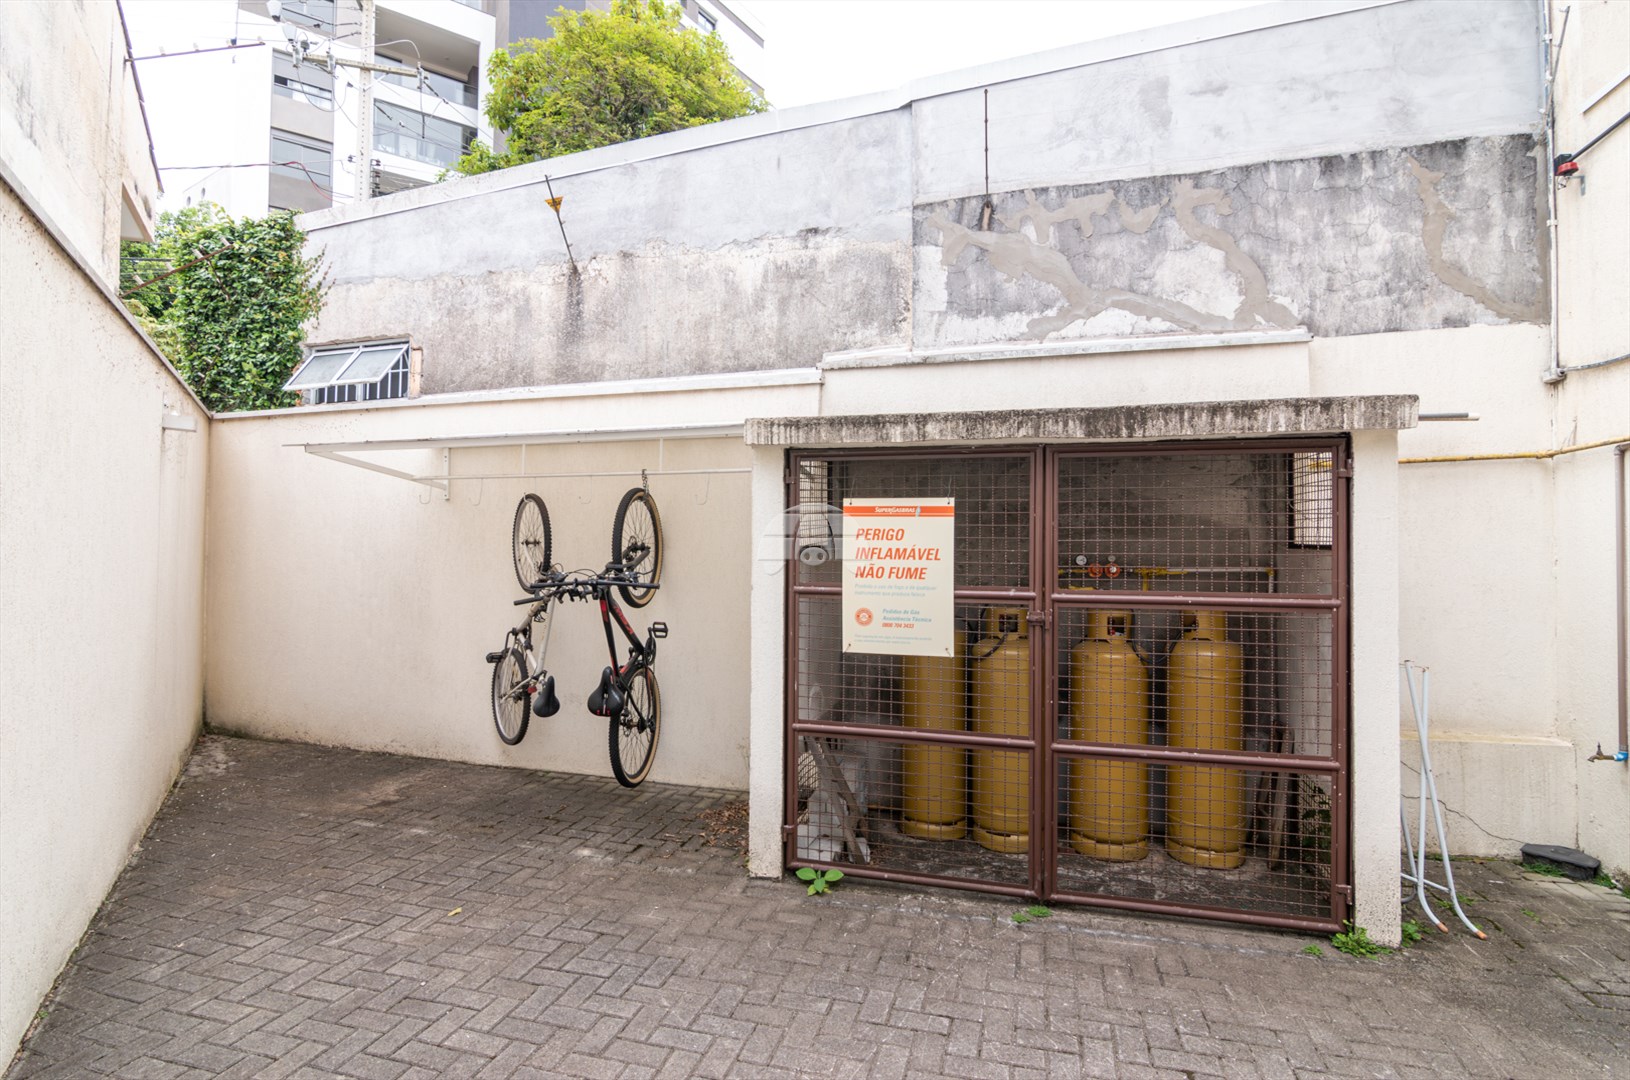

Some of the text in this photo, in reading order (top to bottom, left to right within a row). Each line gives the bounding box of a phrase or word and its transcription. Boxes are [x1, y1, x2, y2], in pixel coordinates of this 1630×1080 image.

[856, 528, 905, 541] PERIGO
[855, 544, 941, 561] INFLAMÁVEL
[855, 563, 928, 580] NÃO FUME
